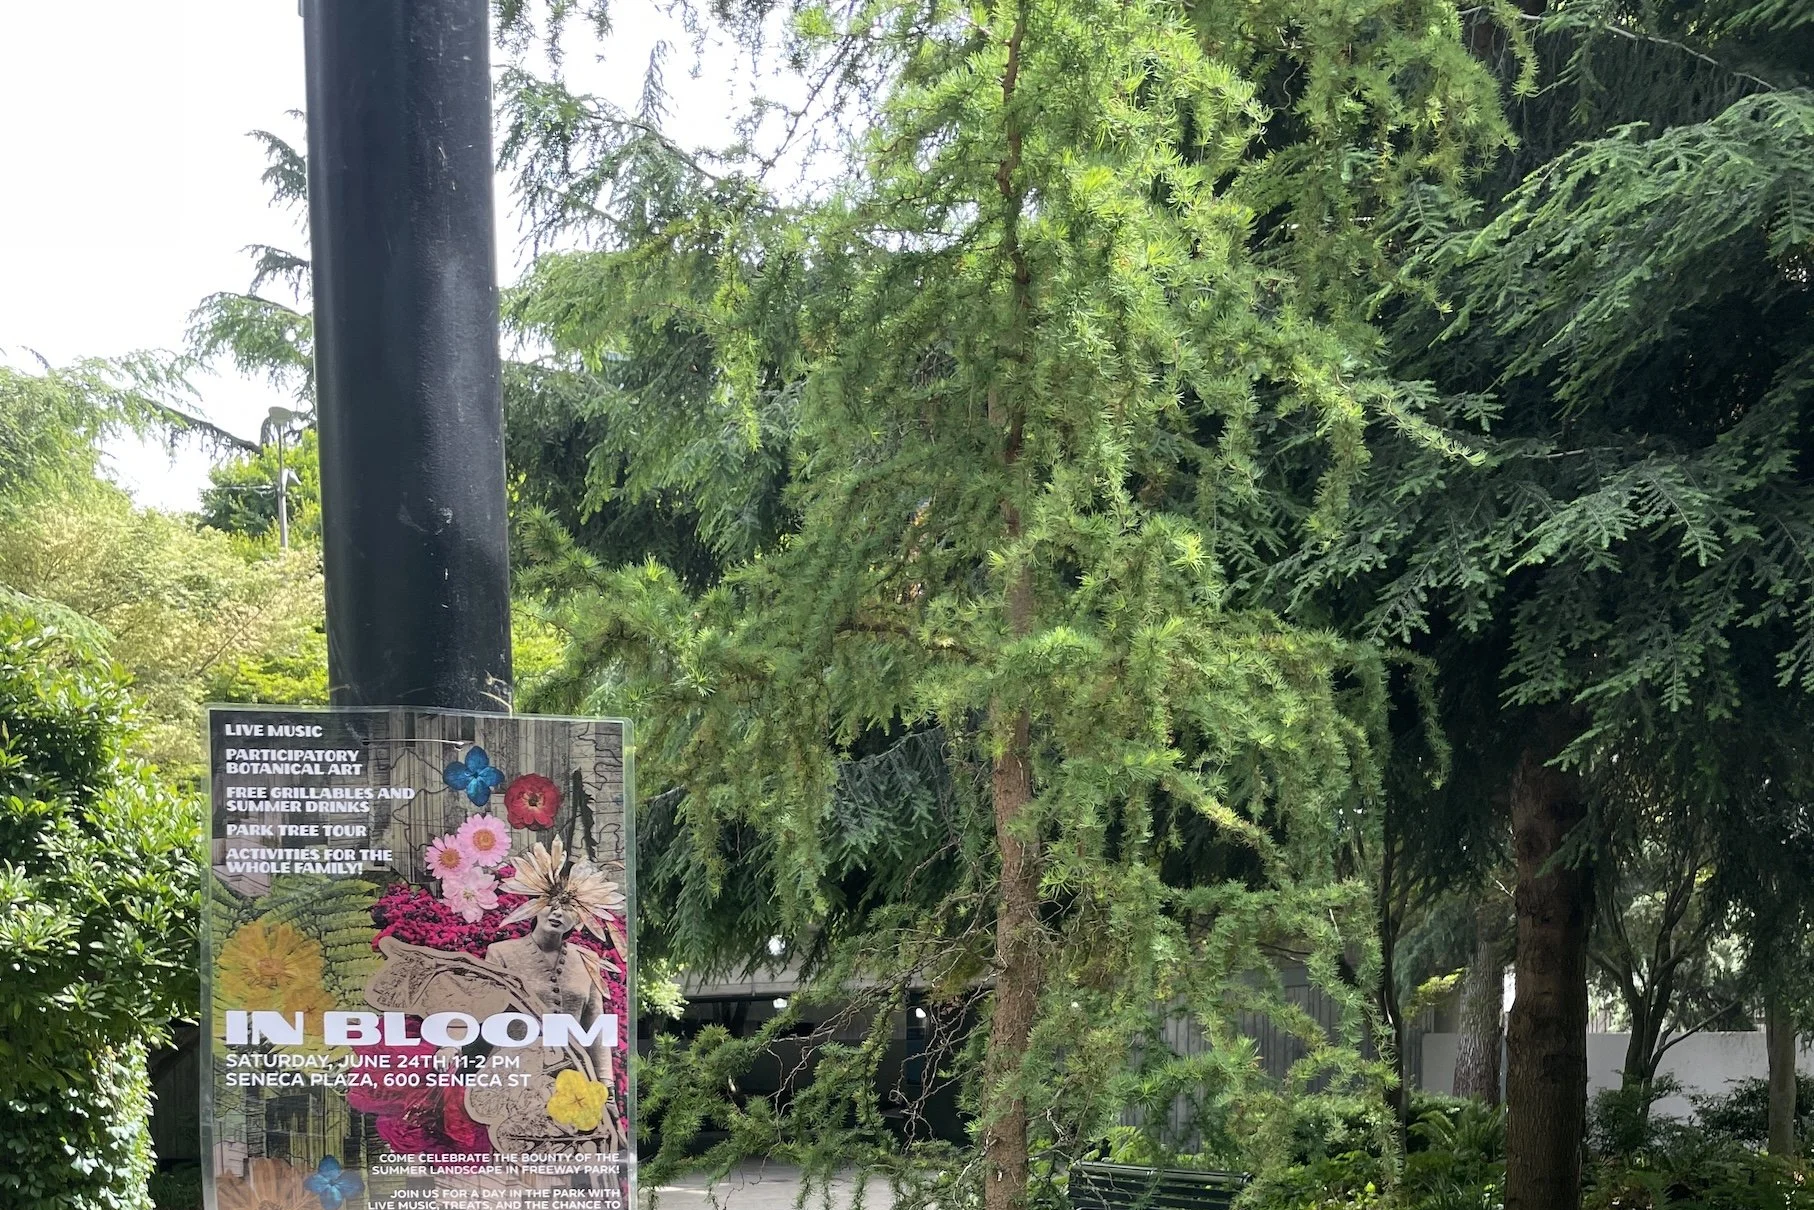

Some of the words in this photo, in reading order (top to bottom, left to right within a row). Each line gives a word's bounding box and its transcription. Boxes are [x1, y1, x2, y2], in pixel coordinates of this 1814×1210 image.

[225, 724, 264, 736] LIVE
[268, 725, 323, 737] MUSIC
[226, 749, 359, 762] PARTICIPATORY
[226, 763, 324, 775] BOTANICAL
[328, 764, 362, 775] ART
[226, 787, 267, 798] FREE
[271, 788, 374, 799] GRILLABLES
[377, 788, 415, 800] AND
[226, 801, 301, 811] SUMMER
[306, 801, 370, 812] DRINKS
[226, 824, 274, 836] PARK
[278, 825, 319, 836] TREE
[323, 825, 366, 837] TOUR
[226, 849, 320, 860] ACTIVITIES
[324, 849, 355, 861] FOR
[359, 850, 392, 861] THE
[226, 862, 291, 873] WHOLE
[294, 862, 363, 874] FAMILY!
[226, 1010, 304, 1045] IN
[324, 1011, 619, 1047] BLOOM
[226, 1054, 333, 1070] SATURDAY,
[338, 1055, 390, 1068] JUNE
[397, 1055, 446, 1068] 24TH
[451, 1055, 485, 1068] 11-2
[492, 1056, 520, 1069] PM
[226, 1073, 304, 1086] SENECA
[311, 1073, 377, 1089] PLAZA,
[383, 1073, 420, 1086] 600
[426, 1074, 502, 1087] SENECA
[508, 1074, 531, 1087] ST
[380, 1154, 415, 1162] COME
[418, 1154, 490, 1162] CELEBRATE
[493, 1154, 518, 1162] THE
[521, 1154, 573, 1162] BOUNTY
[575, 1154, 591, 1162] OF
[595, 1153, 619, 1162] THE
[372, 1166, 427, 1175] SUMMER
[430, 1166, 502, 1175] LANDSCAPE
[506, 1166, 518, 1174] IN
[522, 1166, 581, 1174] FREEWAY
[584, 1165, 620, 1174] PARK!
[391, 1190, 419, 1199] JOIN
[423, 1190, 439, 1198] US
[442, 1190, 467, 1198] FOR
[470, 1190, 479, 1198] A
[483, 1190, 507, 1198] DAY
[510, 1189, 522, 1197] IN
[525, 1189, 549, 1197] THE
[553, 1189, 585, 1197] PARK
[588, 1189, 620, 1197] WITH
[368, 1202, 395, 1210] LIVE
[398, 1202, 440, 1210] MUSIC,
[442, 1201, 493, 1210] TREATS,
[496, 1201, 521, 1209] AND
[524, 1201, 549, 1209] THE
[552, 1201, 601, 1209] CHANCE
[605, 1201, 621, 1209] TO
